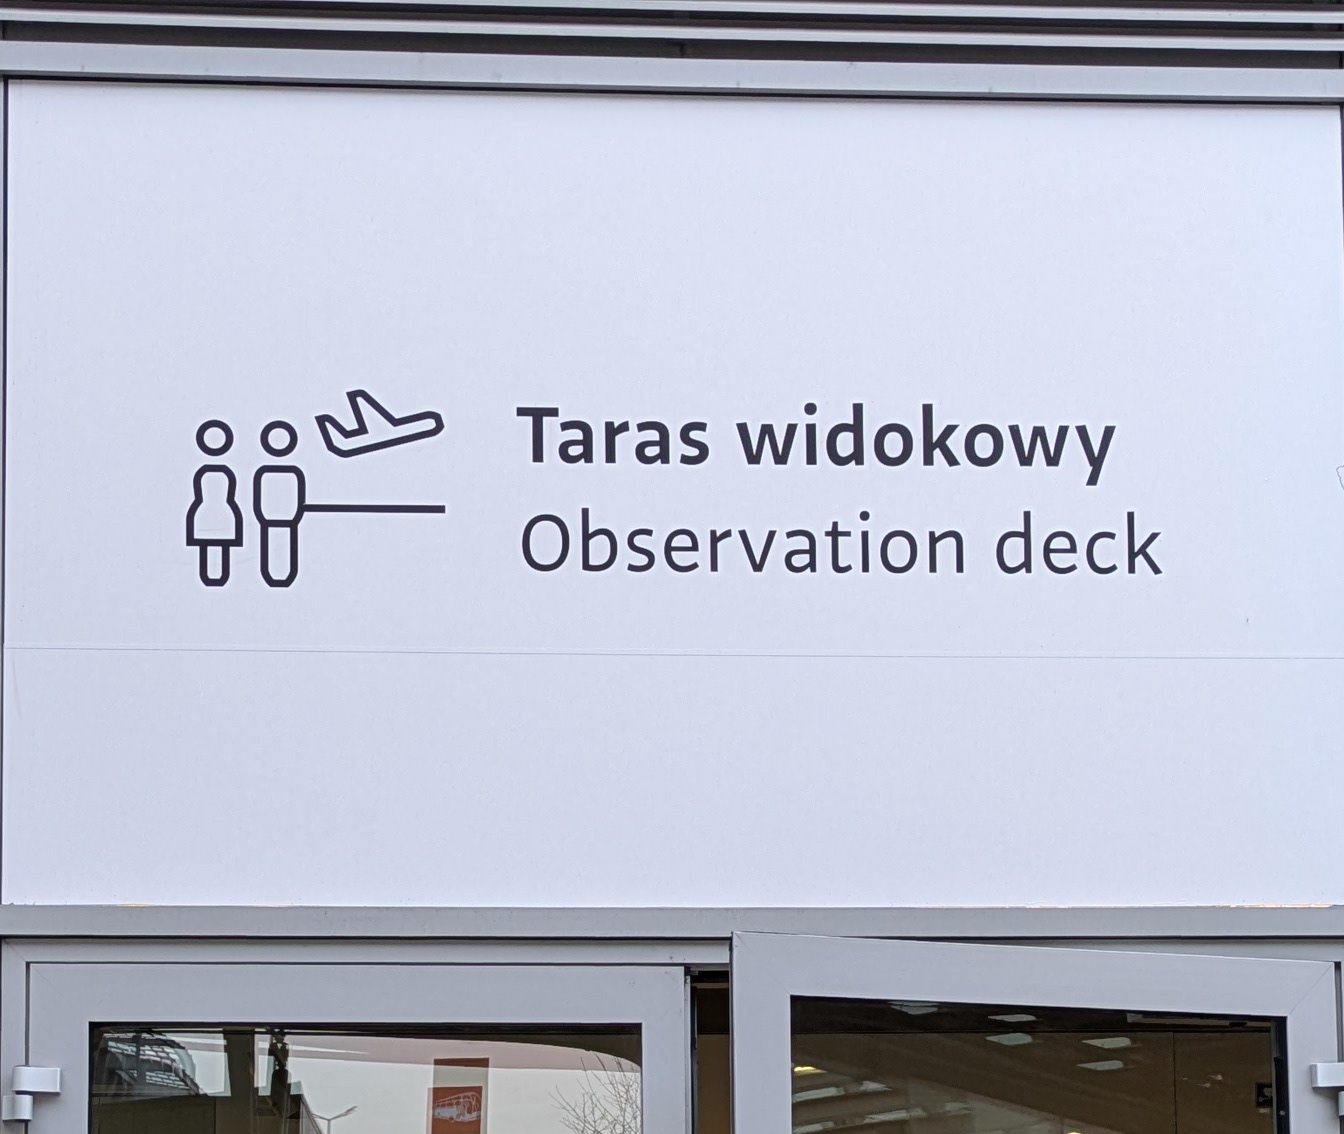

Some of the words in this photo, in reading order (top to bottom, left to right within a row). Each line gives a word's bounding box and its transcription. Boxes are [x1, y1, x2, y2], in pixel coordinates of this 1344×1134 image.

[516, 405, 711, 467] Taras
[734, 402, 1117, 487] widokowy
[520, 507, 964, 575] Observation
[994, 510, 1164, 576] deck
